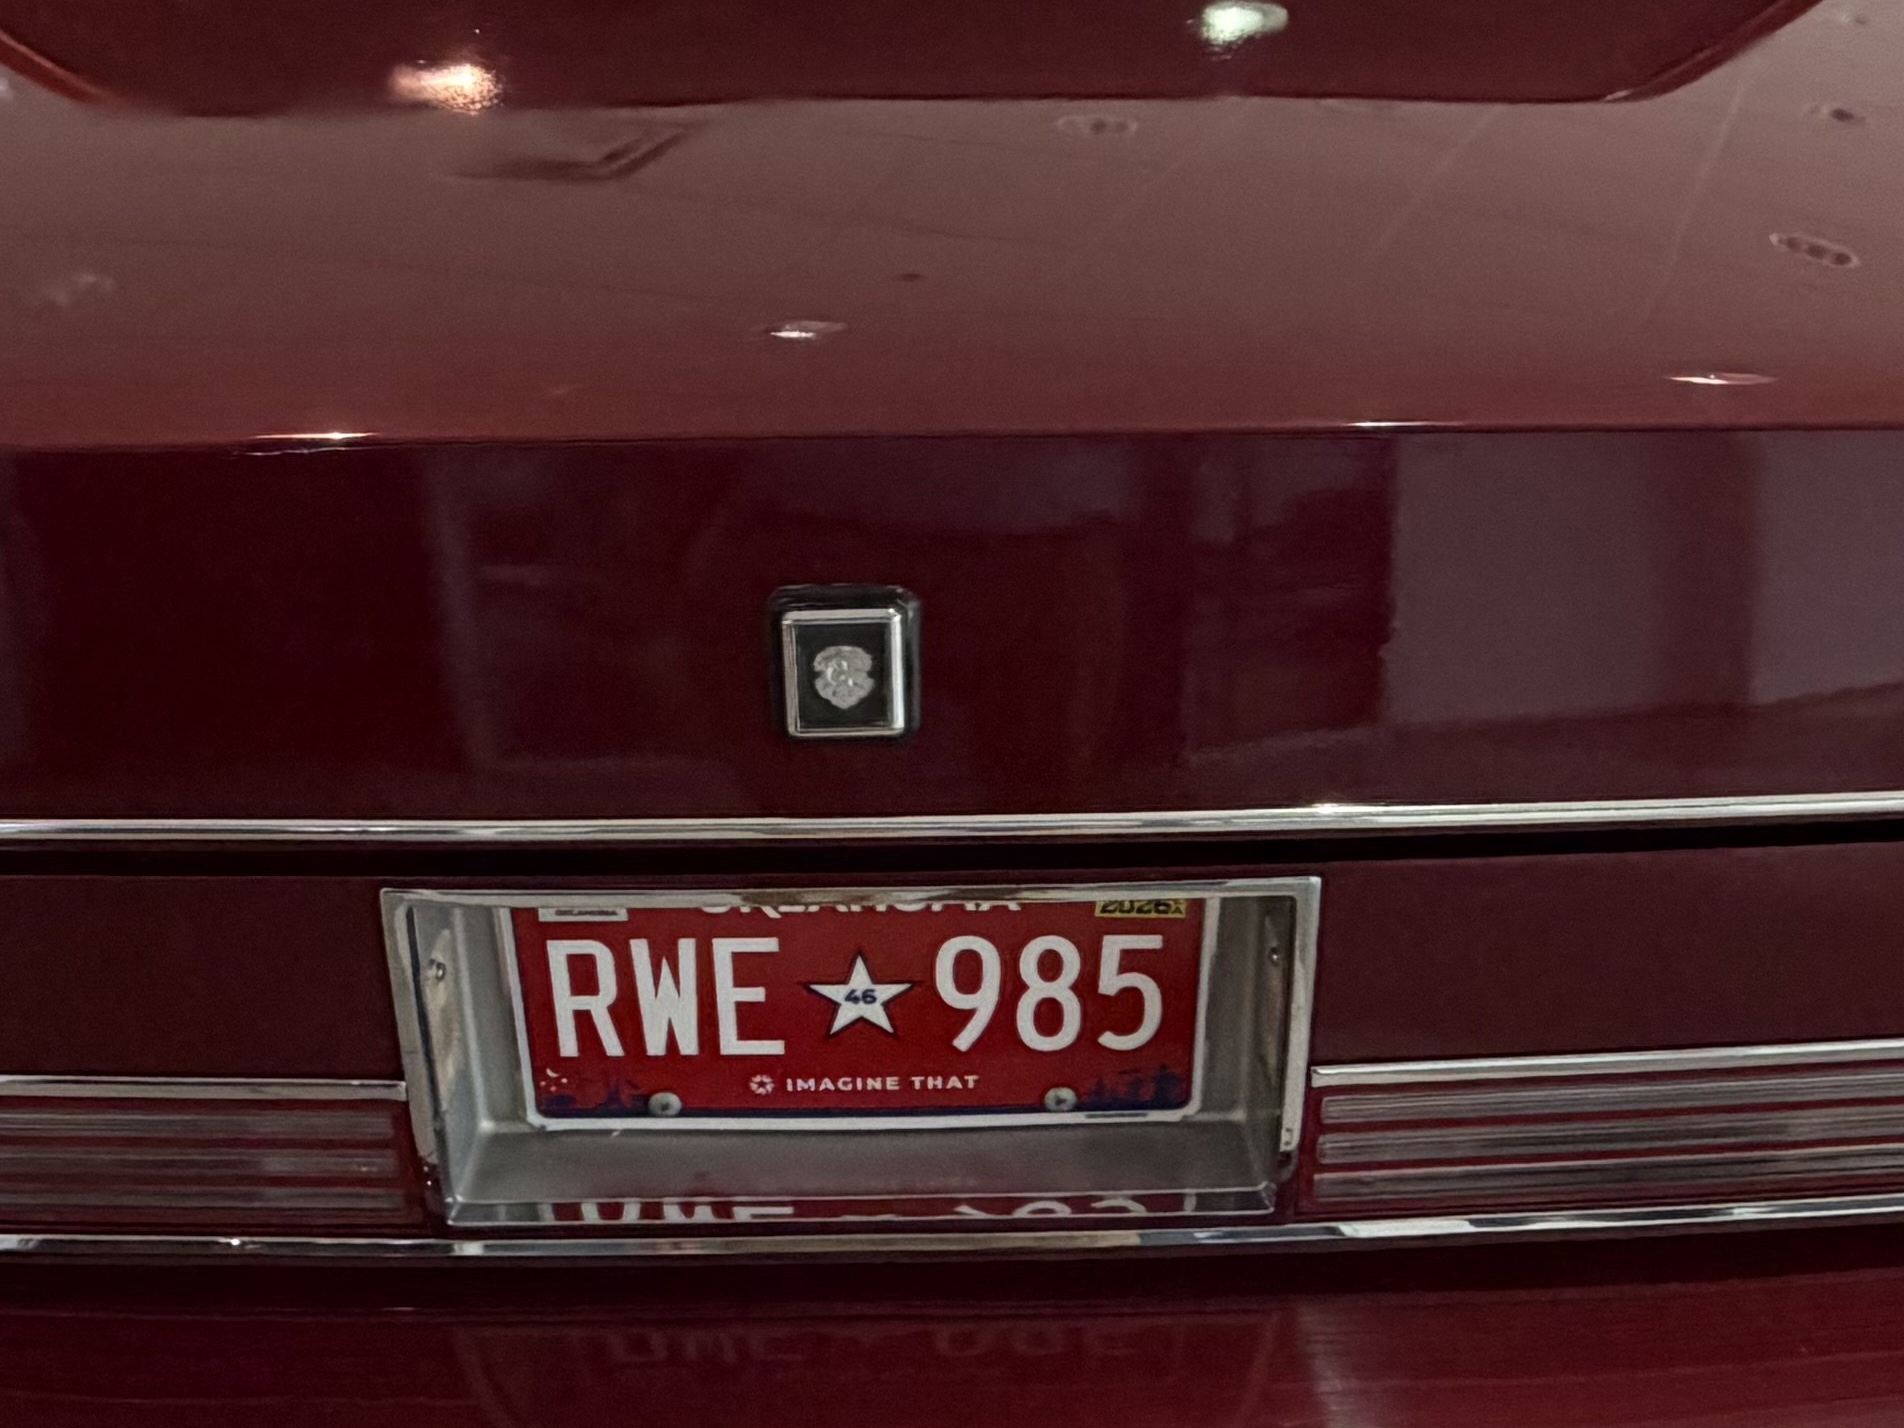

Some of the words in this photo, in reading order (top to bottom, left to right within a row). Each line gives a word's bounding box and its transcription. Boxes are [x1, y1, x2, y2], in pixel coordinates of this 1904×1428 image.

[546, 937, 786, 1057] RWE
[935, 934, 1164, 1053] 985
[844, 988, 878, 1005] 46
[786, 1076, 901, 1092] IMAGINE
[910, 1075, 980, 1091] THAT
